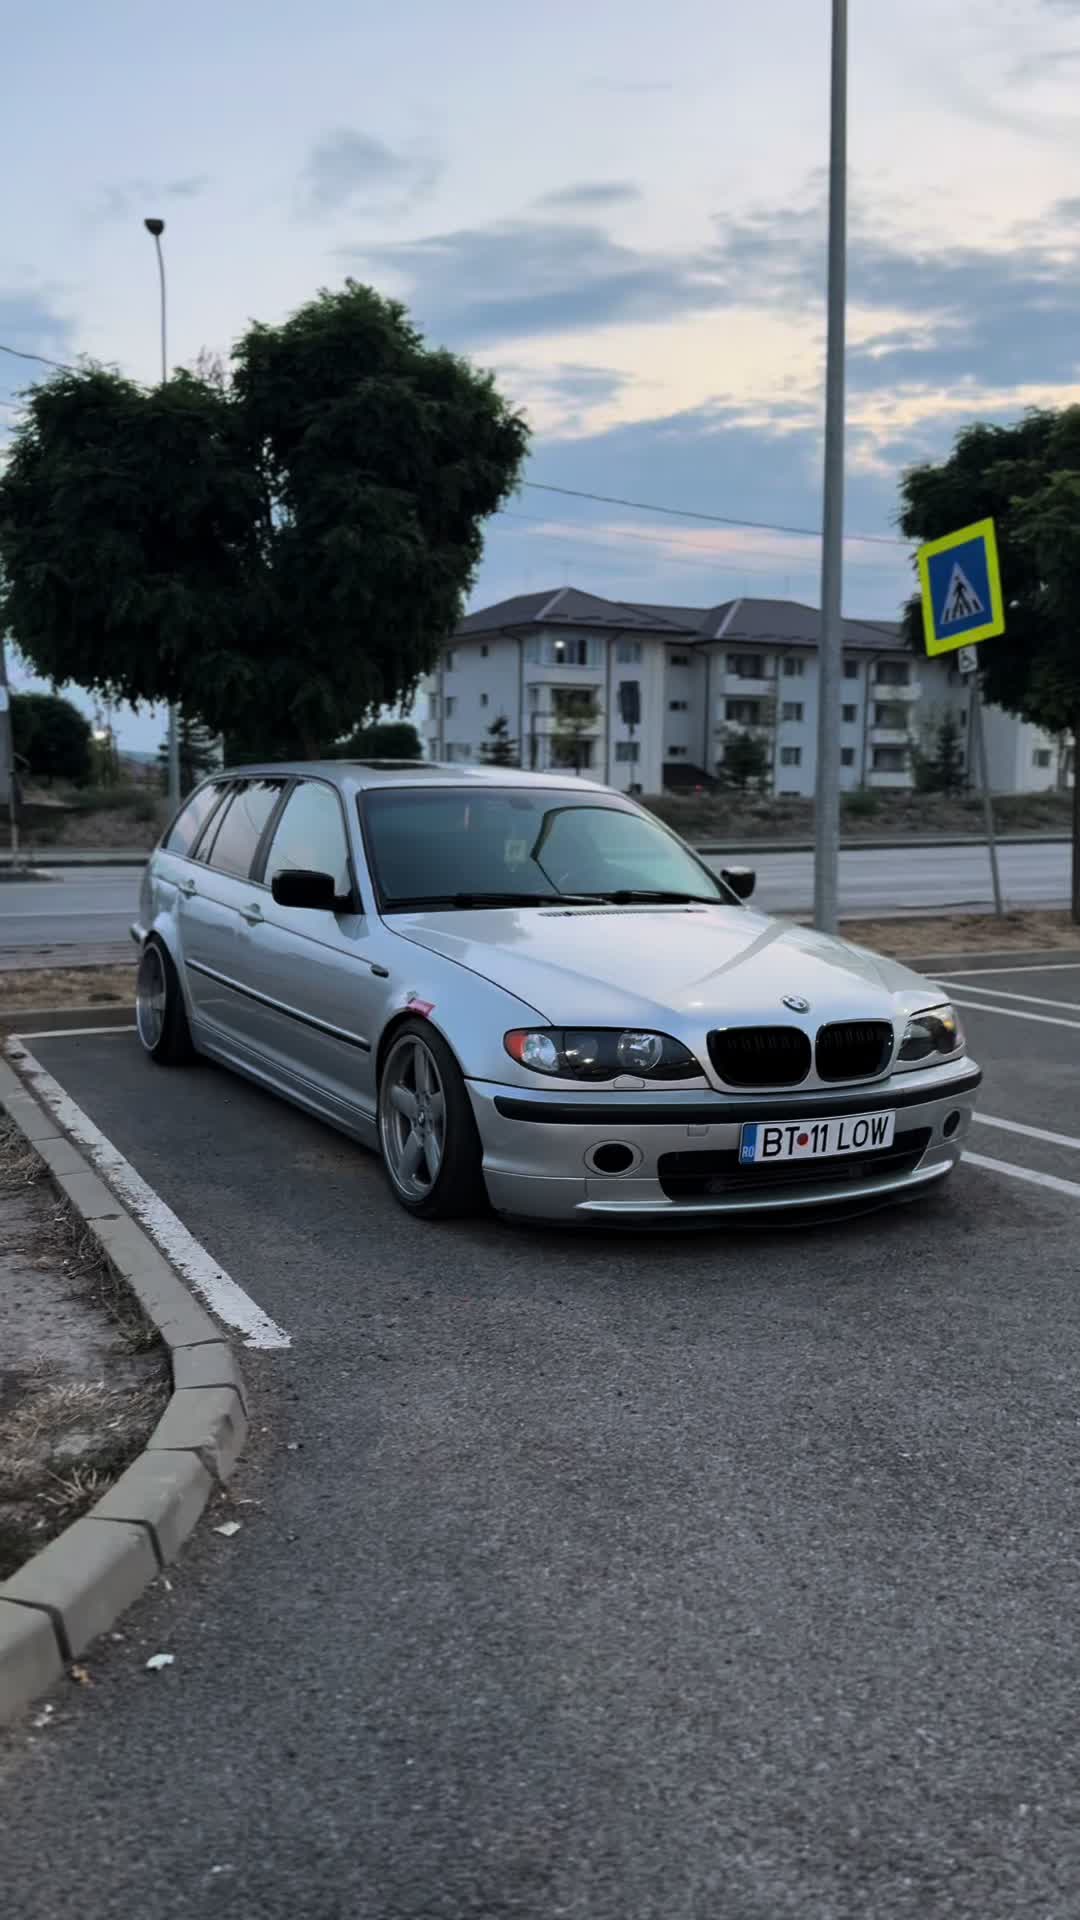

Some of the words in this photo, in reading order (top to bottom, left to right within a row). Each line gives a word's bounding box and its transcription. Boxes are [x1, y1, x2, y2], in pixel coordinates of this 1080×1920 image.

[762, 1126, 800, 1157] BT
[811, 1124, 829, 1153] 11
[837, 1115, 889, 1151] LOW
[742, 1146, 754, 1158] RO
